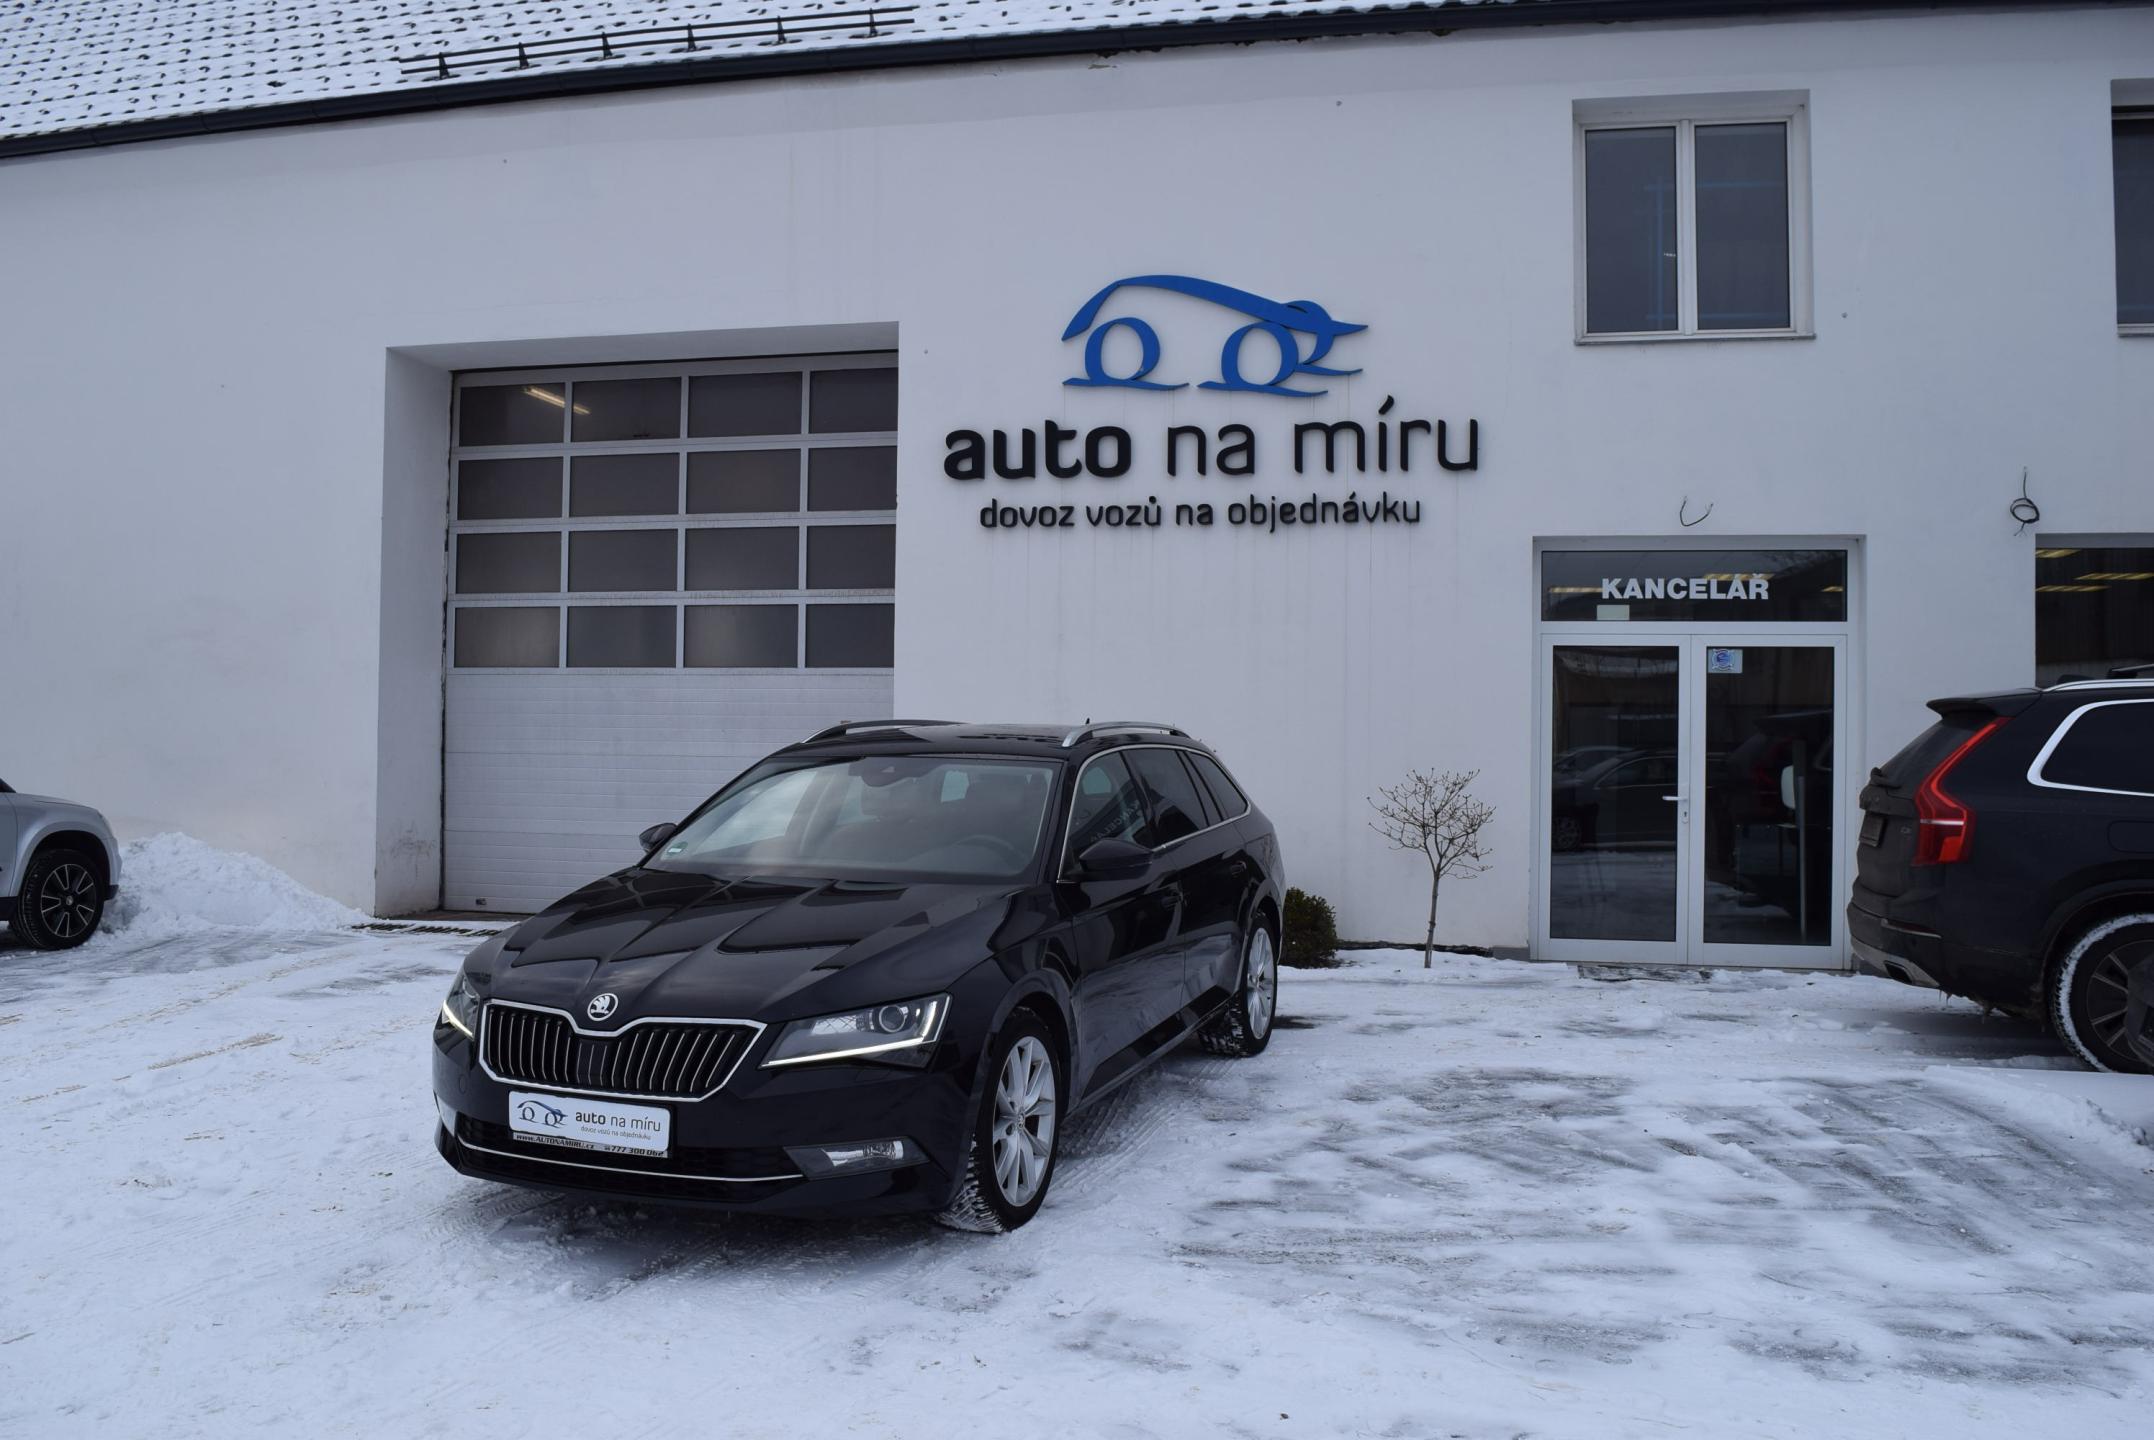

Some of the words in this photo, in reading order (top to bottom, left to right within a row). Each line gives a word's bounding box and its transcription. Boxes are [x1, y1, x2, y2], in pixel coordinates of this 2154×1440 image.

[944, 419, 1132, 480] auto
[1167, 423, 1255, 477] na
[1294, 395, 1479, 473] míru
[979, 498, 1075, 529] dovoz
[1086, 495, 1162, 527] vozů
[1176, 498, 1214, 526] na
[1228, 492, 1421, 533] objednávku
[1602, 573, 1769, 600] KANCELÁŘ
[576, 1112, 605, 1124] auto
[610, 1116, 626, 1128] na
[630, 1116, 661, 1132] míru
